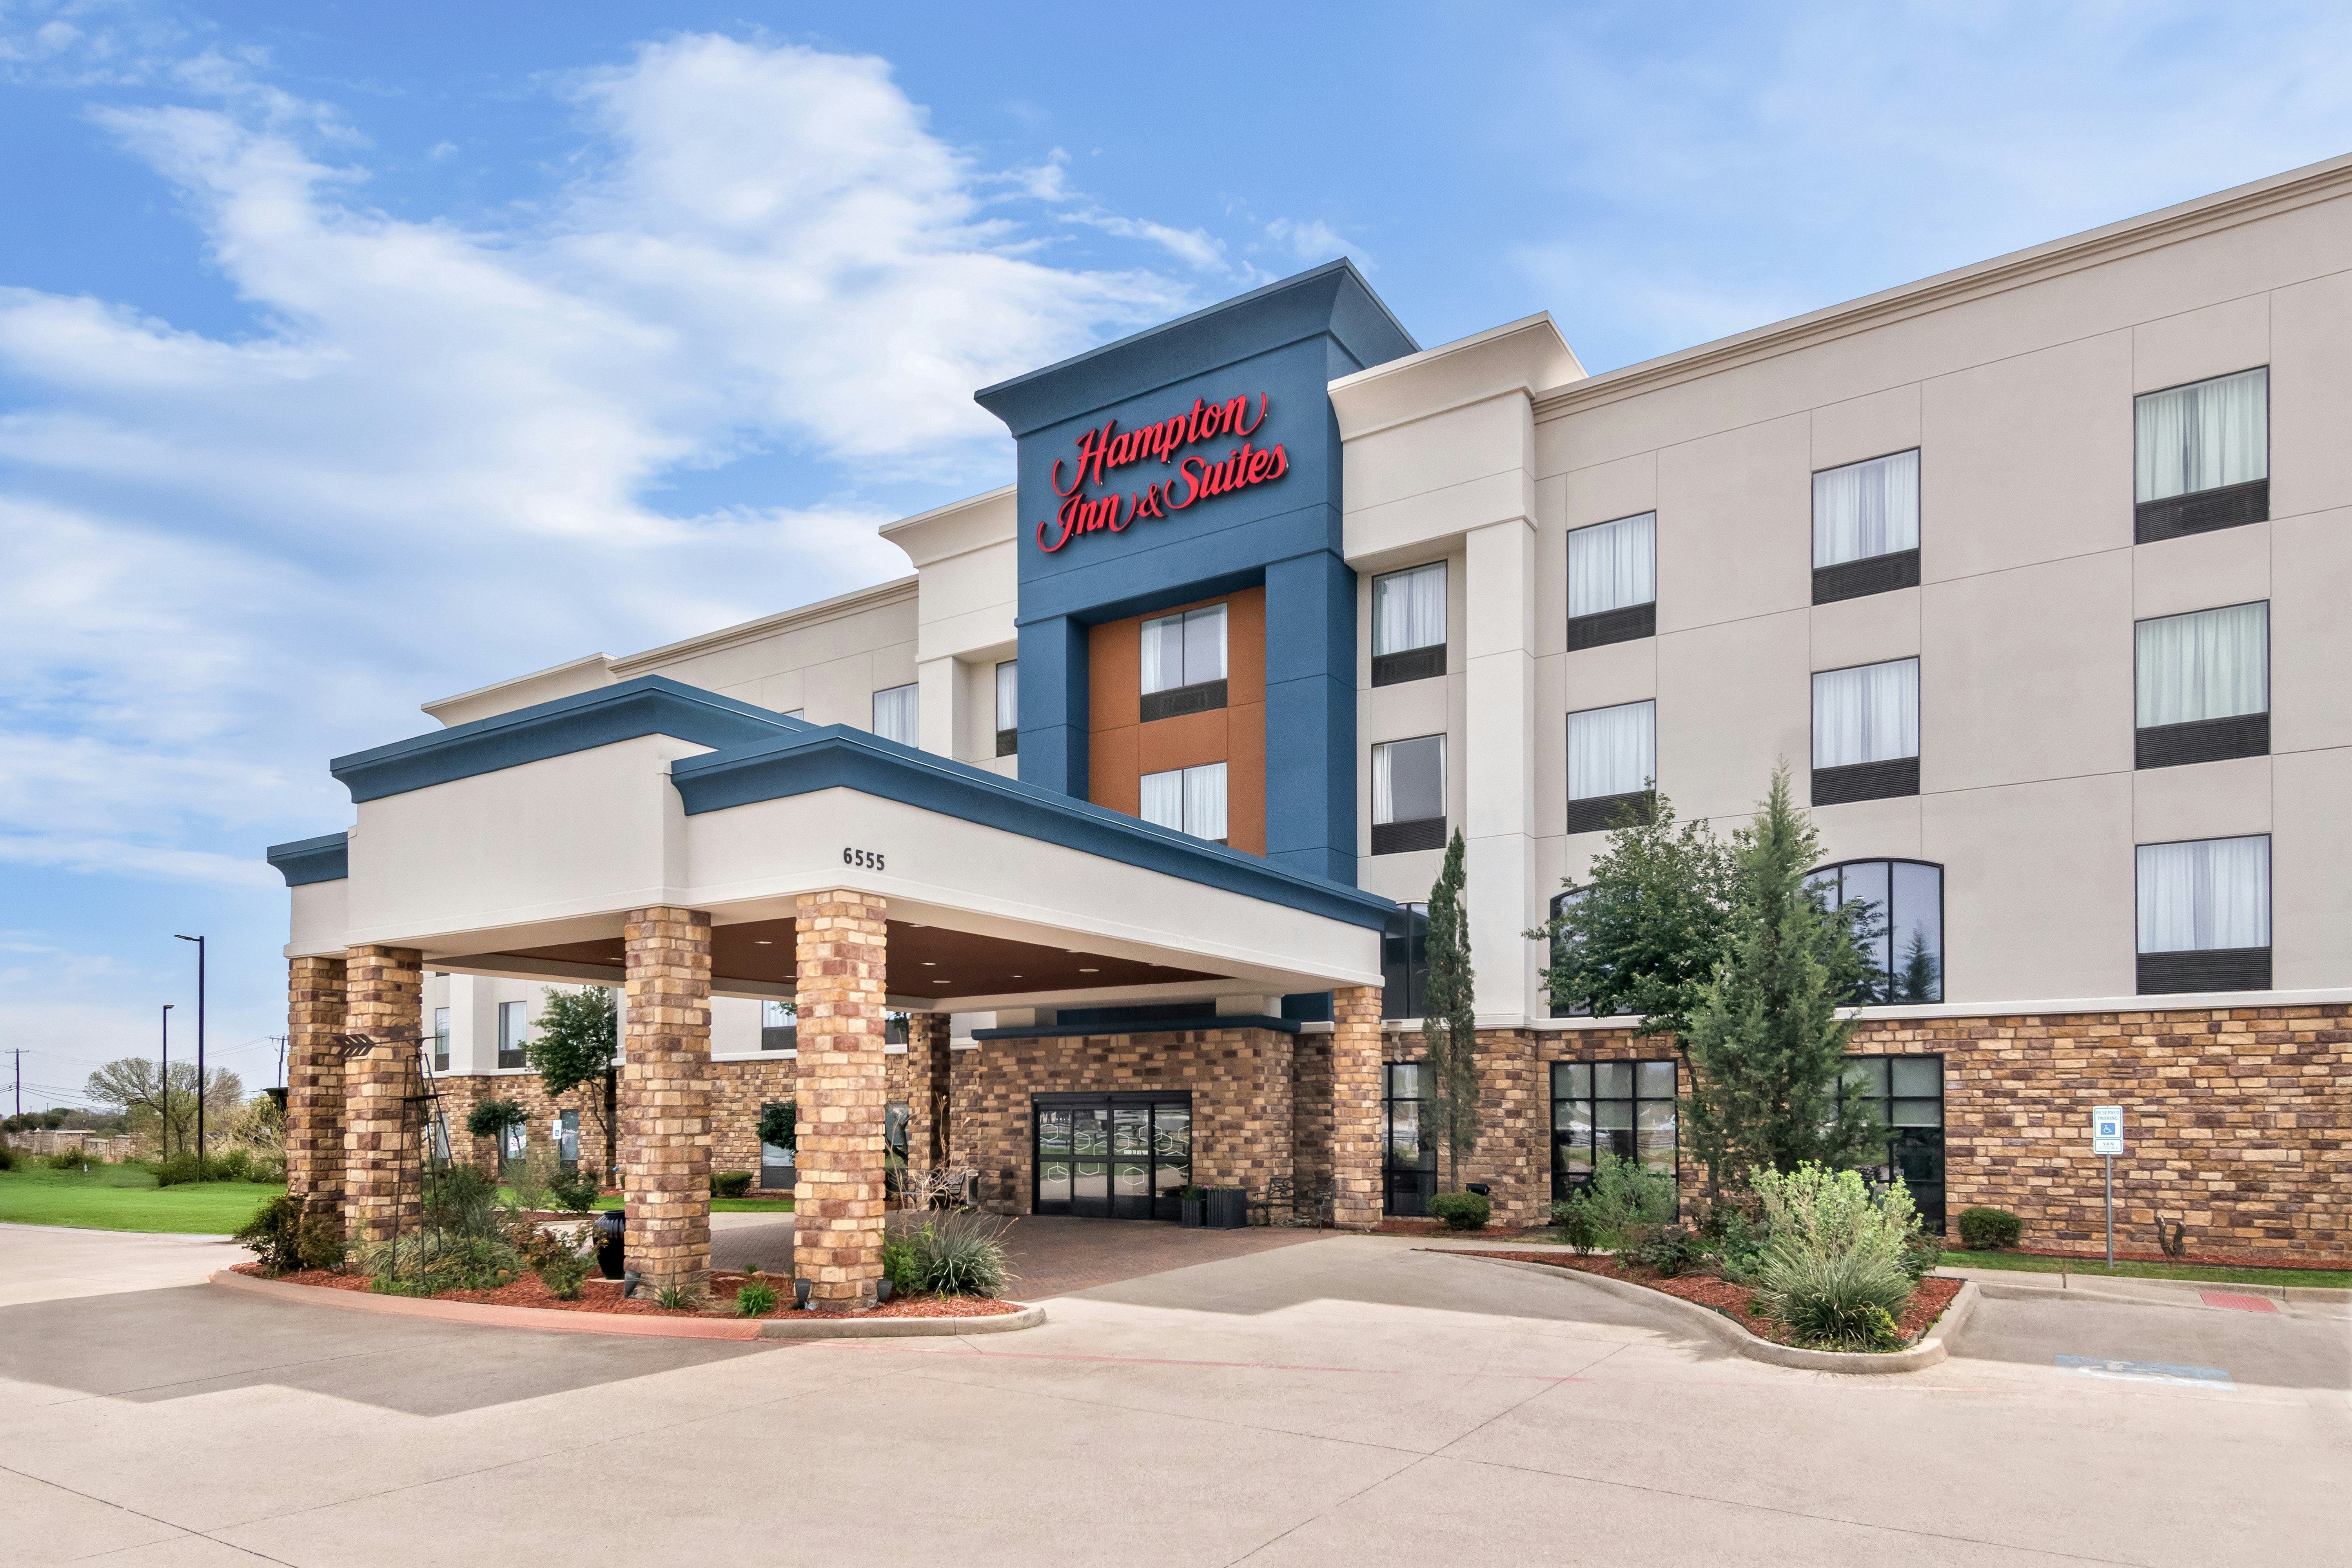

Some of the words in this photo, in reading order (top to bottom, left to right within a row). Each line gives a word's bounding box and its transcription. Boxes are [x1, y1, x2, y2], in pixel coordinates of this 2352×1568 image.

[1052, 393, 1267, 496] Hampton
[1037, 493, 1137, 552] Inn
[1138, 483, 1165, 517] &
[1164, 443, 1288, 509] Suites
[844, 848, 885, 871] 6555
